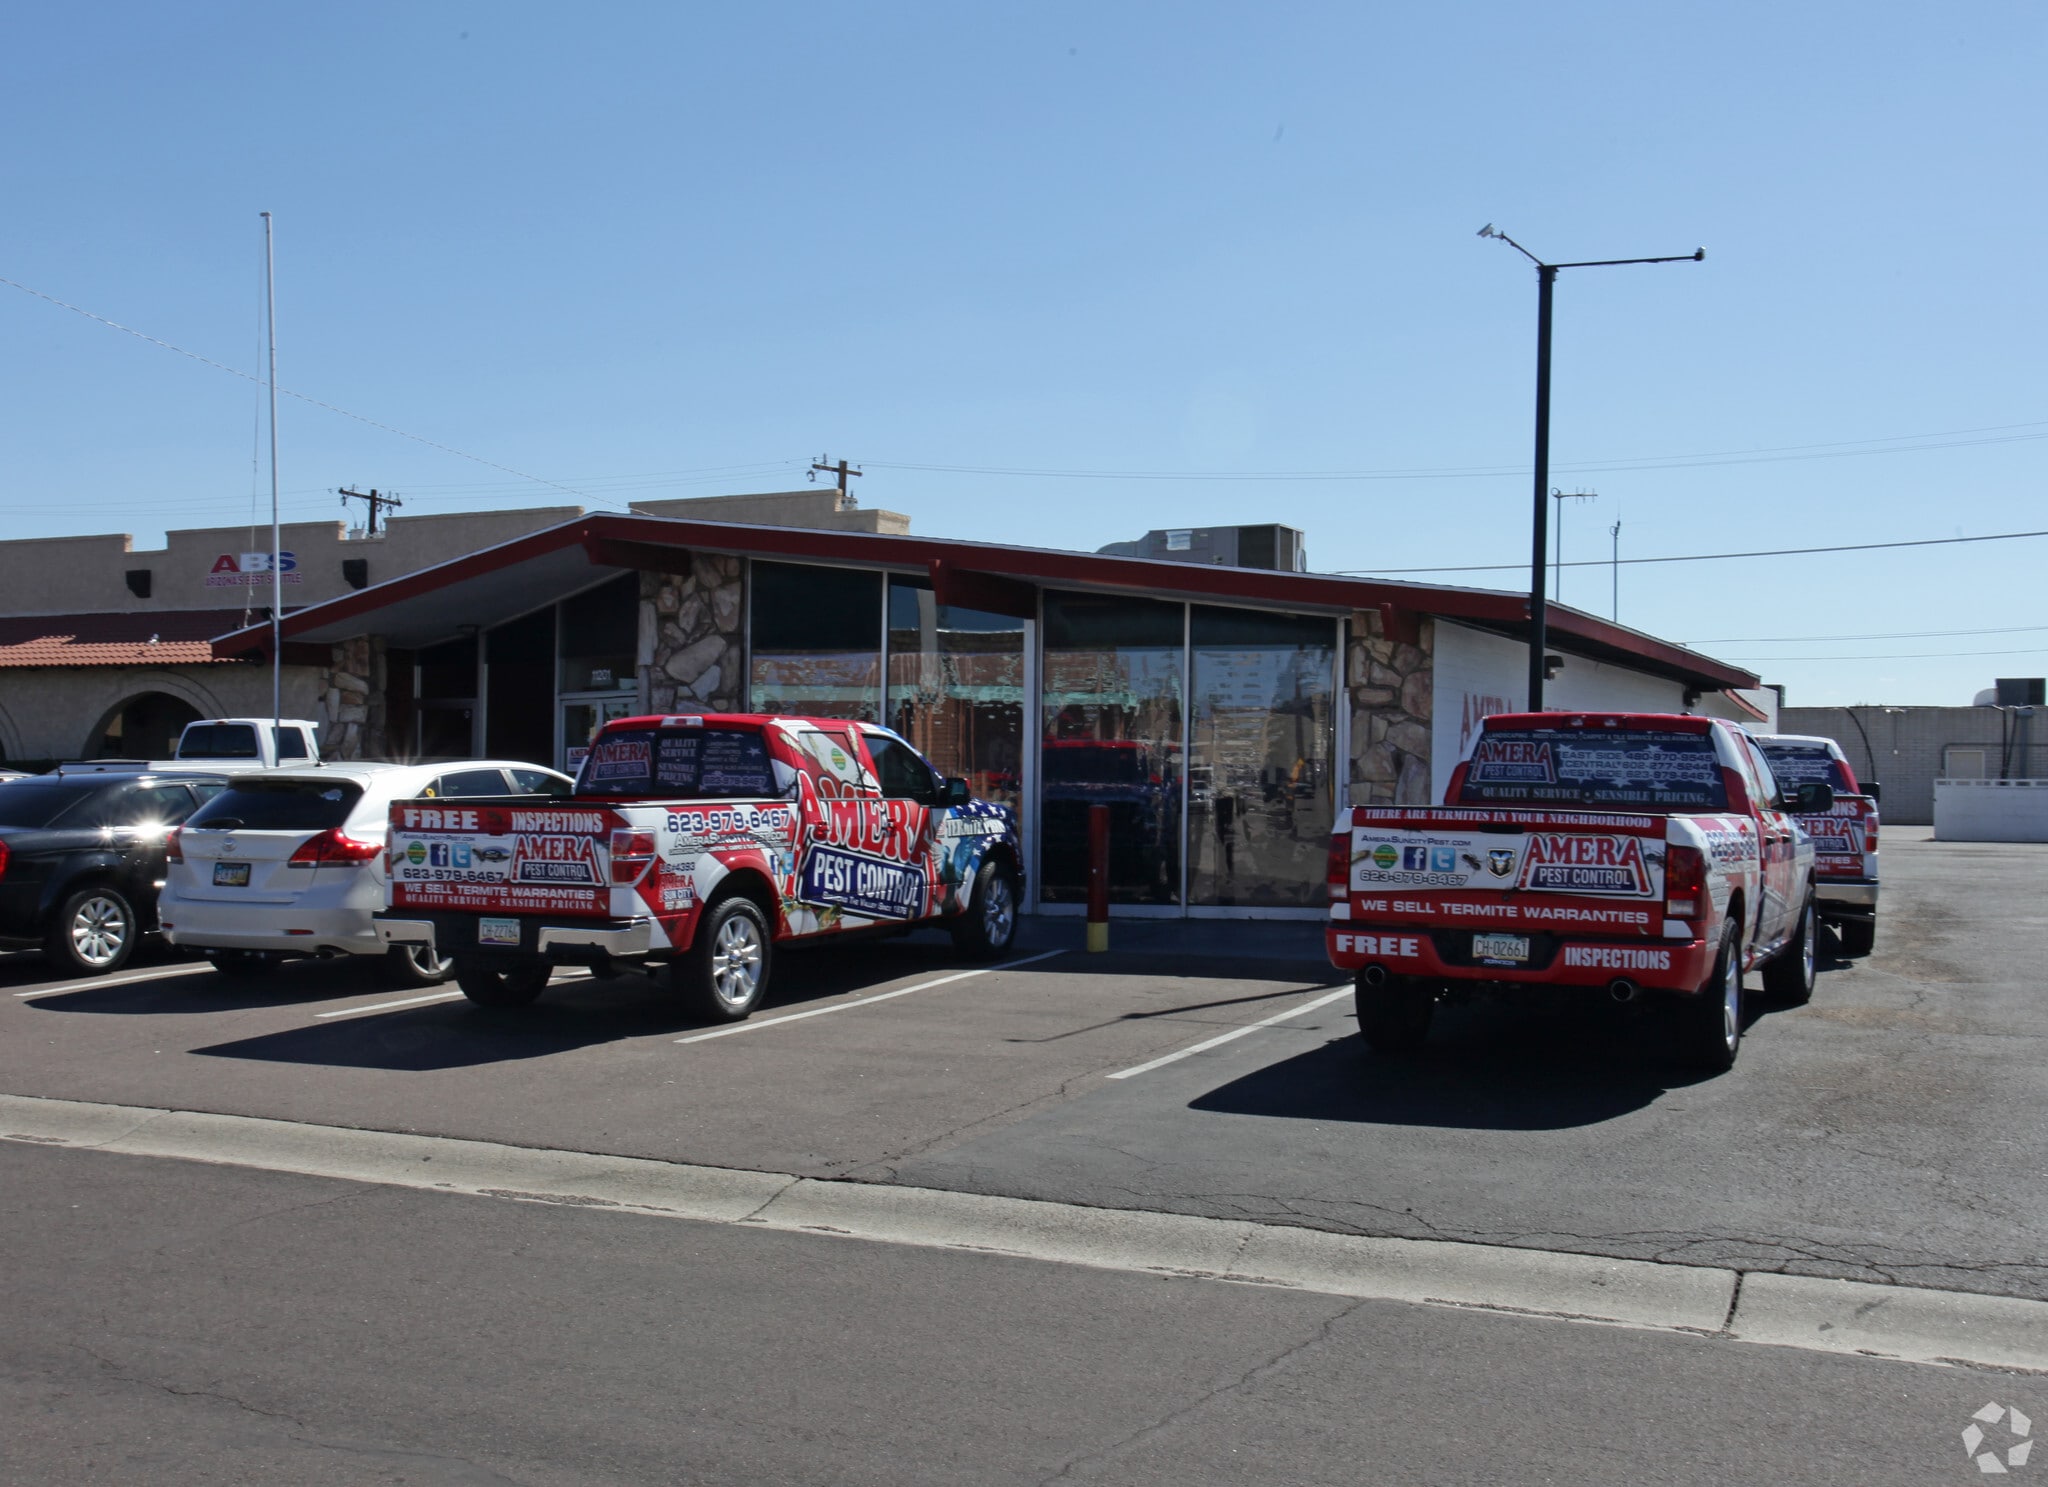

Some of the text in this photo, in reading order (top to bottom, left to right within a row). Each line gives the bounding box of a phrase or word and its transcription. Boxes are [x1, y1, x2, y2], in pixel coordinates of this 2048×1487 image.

[210, 551, 297, 574] ABS
[246, 574, 265, 585] BEST
[661, 738, 697, 747] QUALITY
[589, 741, 652, 772] AMERA
[660, 748, 696, 757] SERVICE
[1471, 742, 1556, 774] AMERA
[1562, 751, 1593, 760] EAST
[1595, 751, 1623, 760] SIDE
[658, 762, 695, 772] SENSIBLE
[658, 771, 693, 781] PRICING
[1560, 768, 1593, 777] WEST
[1595, 769, 1623, 778] SIDE
[1482, 787, 1705, 802] QUALITY SERVICE SENSIBLE PRICING
[403, 808, 479, 830] FREE
[511, 811, 604, 833] INSPECTIONS
[667, 810, 790, 833] 623-979-6467
[789, 770, 935, 880] AMERA
[1365, 808, 1652, 828] THERE ARE TERMITES IN YOUR NEIGHBORHOOD
[511, 835, 604, 874] AMERA
[1520, 836, 1649, 878] AMERA
[403, 867, 504, 883] 623-979-6467
[525, 863, 588, 878] PEST CONTROL
[813, 852, 919, 907] PEST CONTROL
[1360, 870, 1469, 887] 623-979-6467
[1539, 868, 1570, 883] PEST
[1572, 869, 1631, 886] CONTROL
[404, 883, 595, 900] WE SELL TERMITE WARRANTIES
[405, 893, 593, 910] QUALITY SERVICE SENSIBLE PRICING
[1361, 899, 1649, 924] WE SELL TERMITE WARRANTIES
[1336, 934, 1419, 957] FREE
[1475, 939, 1527, 957] CH-02661
[1565, 946, 1671, 970] INSPECTIONS
